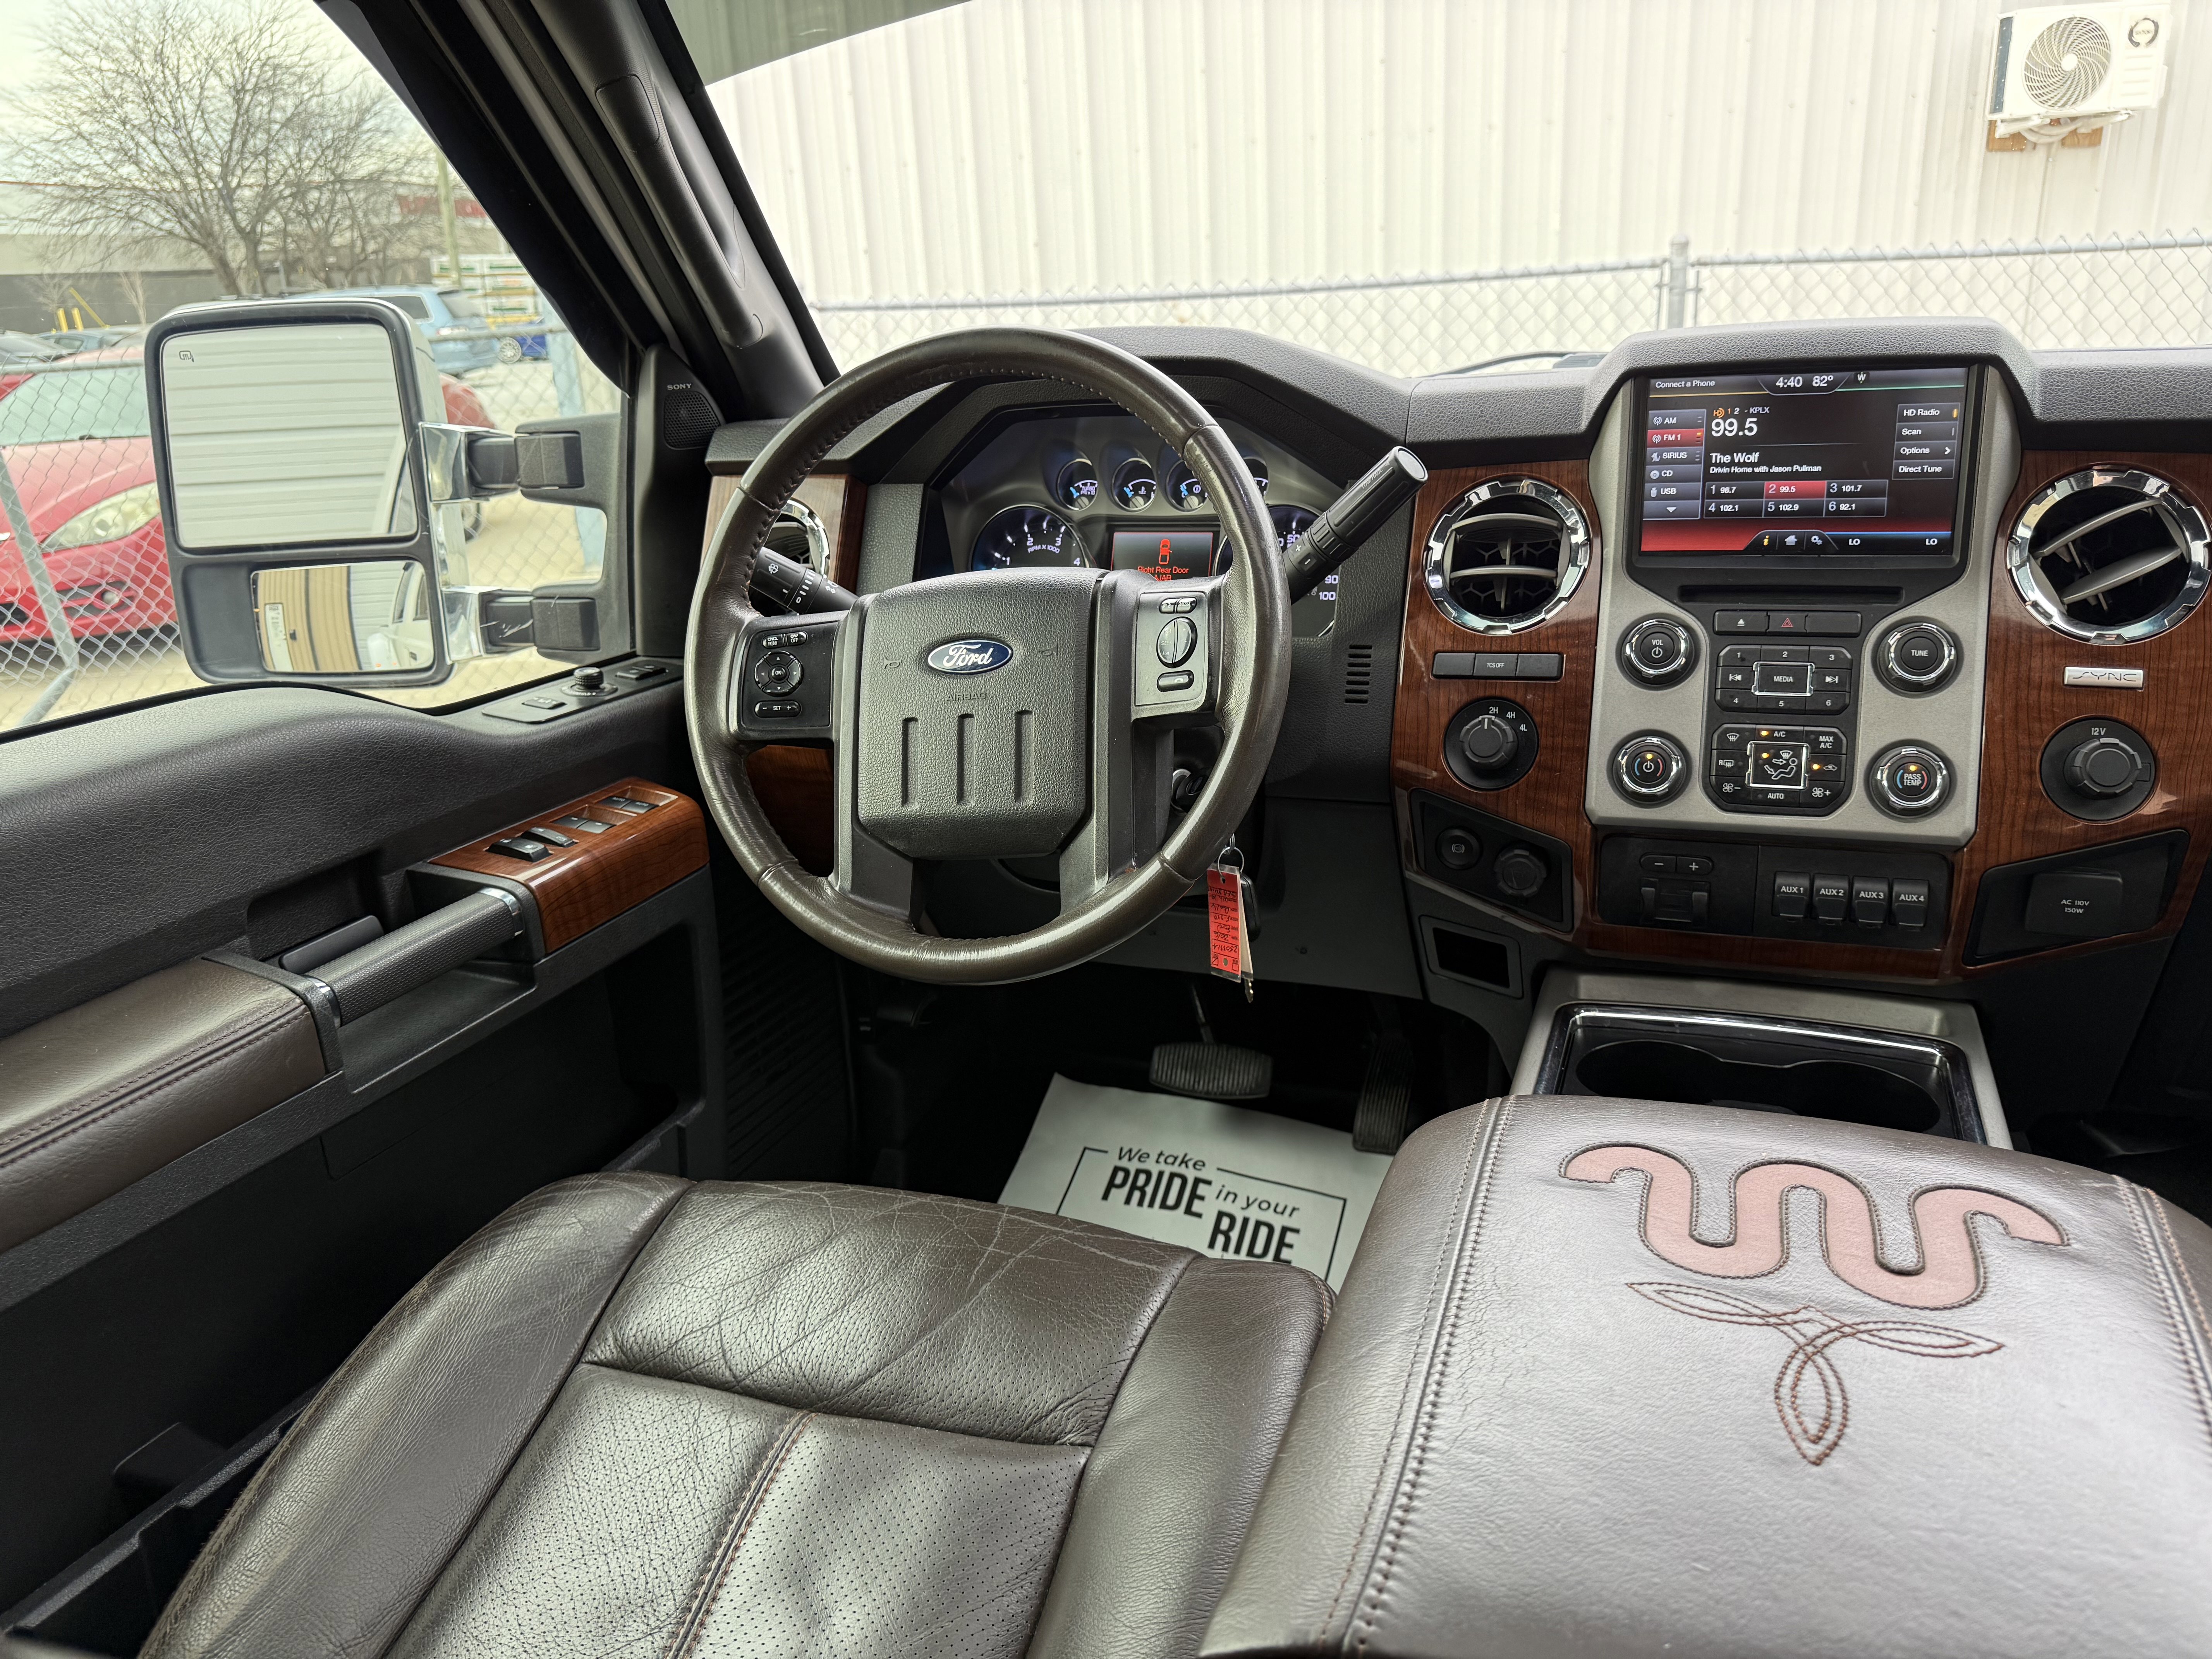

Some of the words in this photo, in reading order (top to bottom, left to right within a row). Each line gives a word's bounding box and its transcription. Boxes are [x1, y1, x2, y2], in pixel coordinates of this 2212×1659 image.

[1656, 380, 1685, 388] Connect
[1776, 376, 1803, 388] 4:40
[1711, 418, 1757, 437] 99.5
[1900, 447, 1930, 455] Options
[1710, 453, 1731, 464] The
[1733, 452, 1759, 463] Wolf
[1711, 485, 1716, 494] 1
[1769, 484, 1776, 493] 2
[1830, 483, 1838, 493] 3
[1709, 503, 1716, 512] 4
[1768, 502, 1775, 512] 5
[1829, 501, 1836, 511] 6
[1027, 538, 1033, 546] 2
[1055, 538, 1061, 546] 3
[1027, 545, 1041, 553] RPM
[1047, 545, 1060, 554] 1000
[1074, 558, 1080, 566] 4
[1325, 575, 1339, 584] 90
[1319, 592, 1336, 600] 100
[943, 644, 994, 667] Ford
[2073, 672, 2136, 682] SYNC
[947, 692, 987, 701] AIRBAG
[1118, 1146, 1150, 1163] We
[1155, 1150, 1206, 1172] take
[1101, 1164, 1212, 1219] PRIDE
[1216, 1184, 1240, 1201] in
[1243, 1195, 1300, 1218] your
[1207, 1209, 1301, 1264] RIDE
